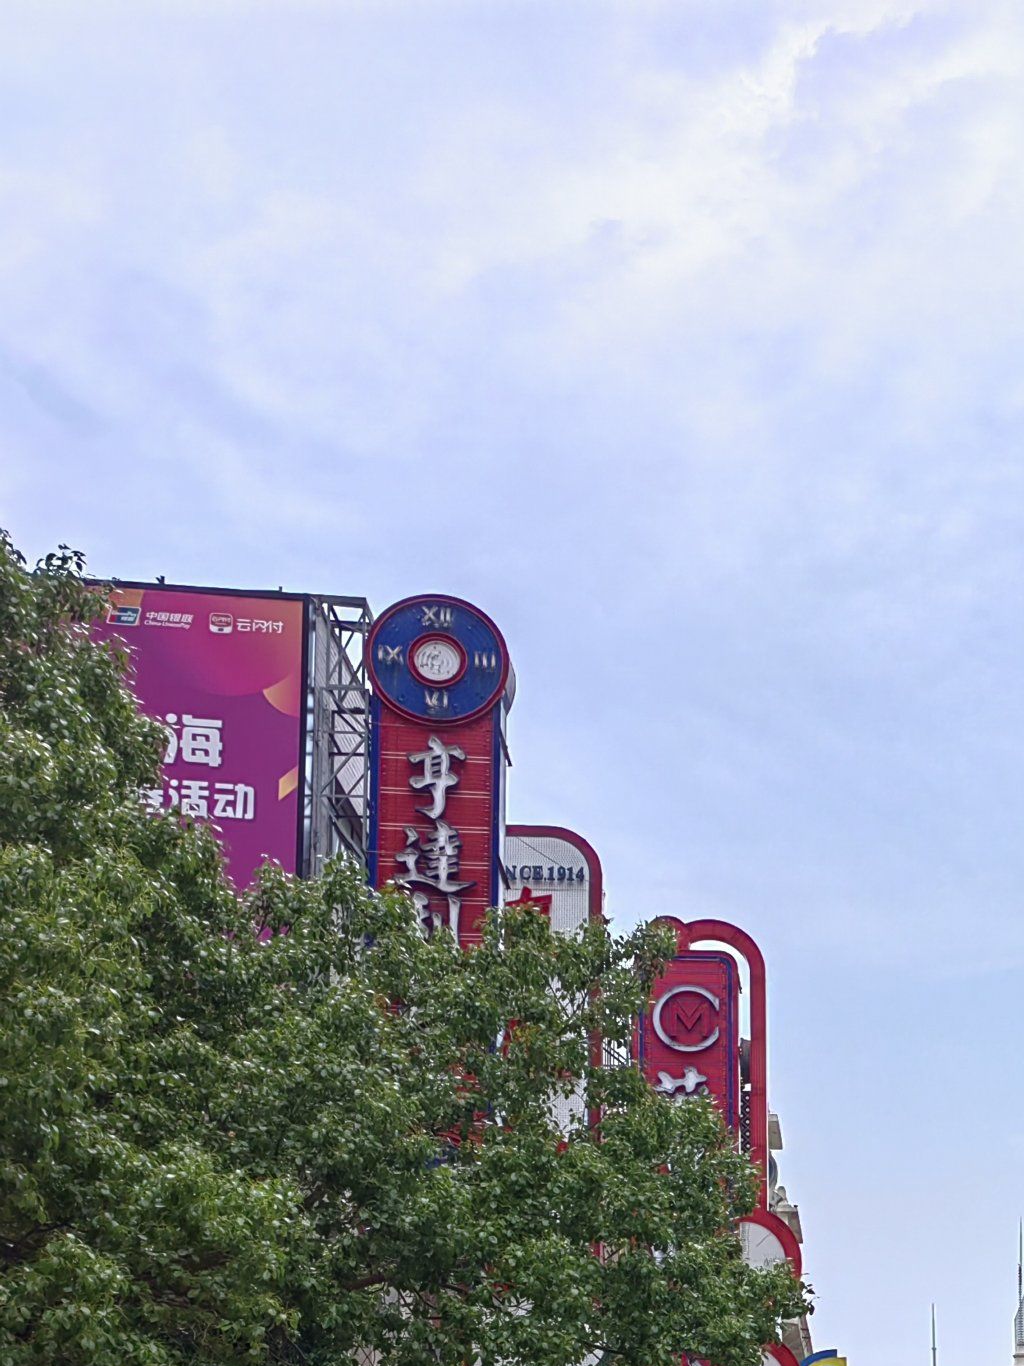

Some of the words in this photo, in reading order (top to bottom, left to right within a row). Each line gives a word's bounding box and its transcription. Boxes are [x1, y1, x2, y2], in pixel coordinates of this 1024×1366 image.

[145, 611, 194, 624] 中国银联
[421, 606, 453, 627] XII
[236, 618, 284, 634] 云闪付
